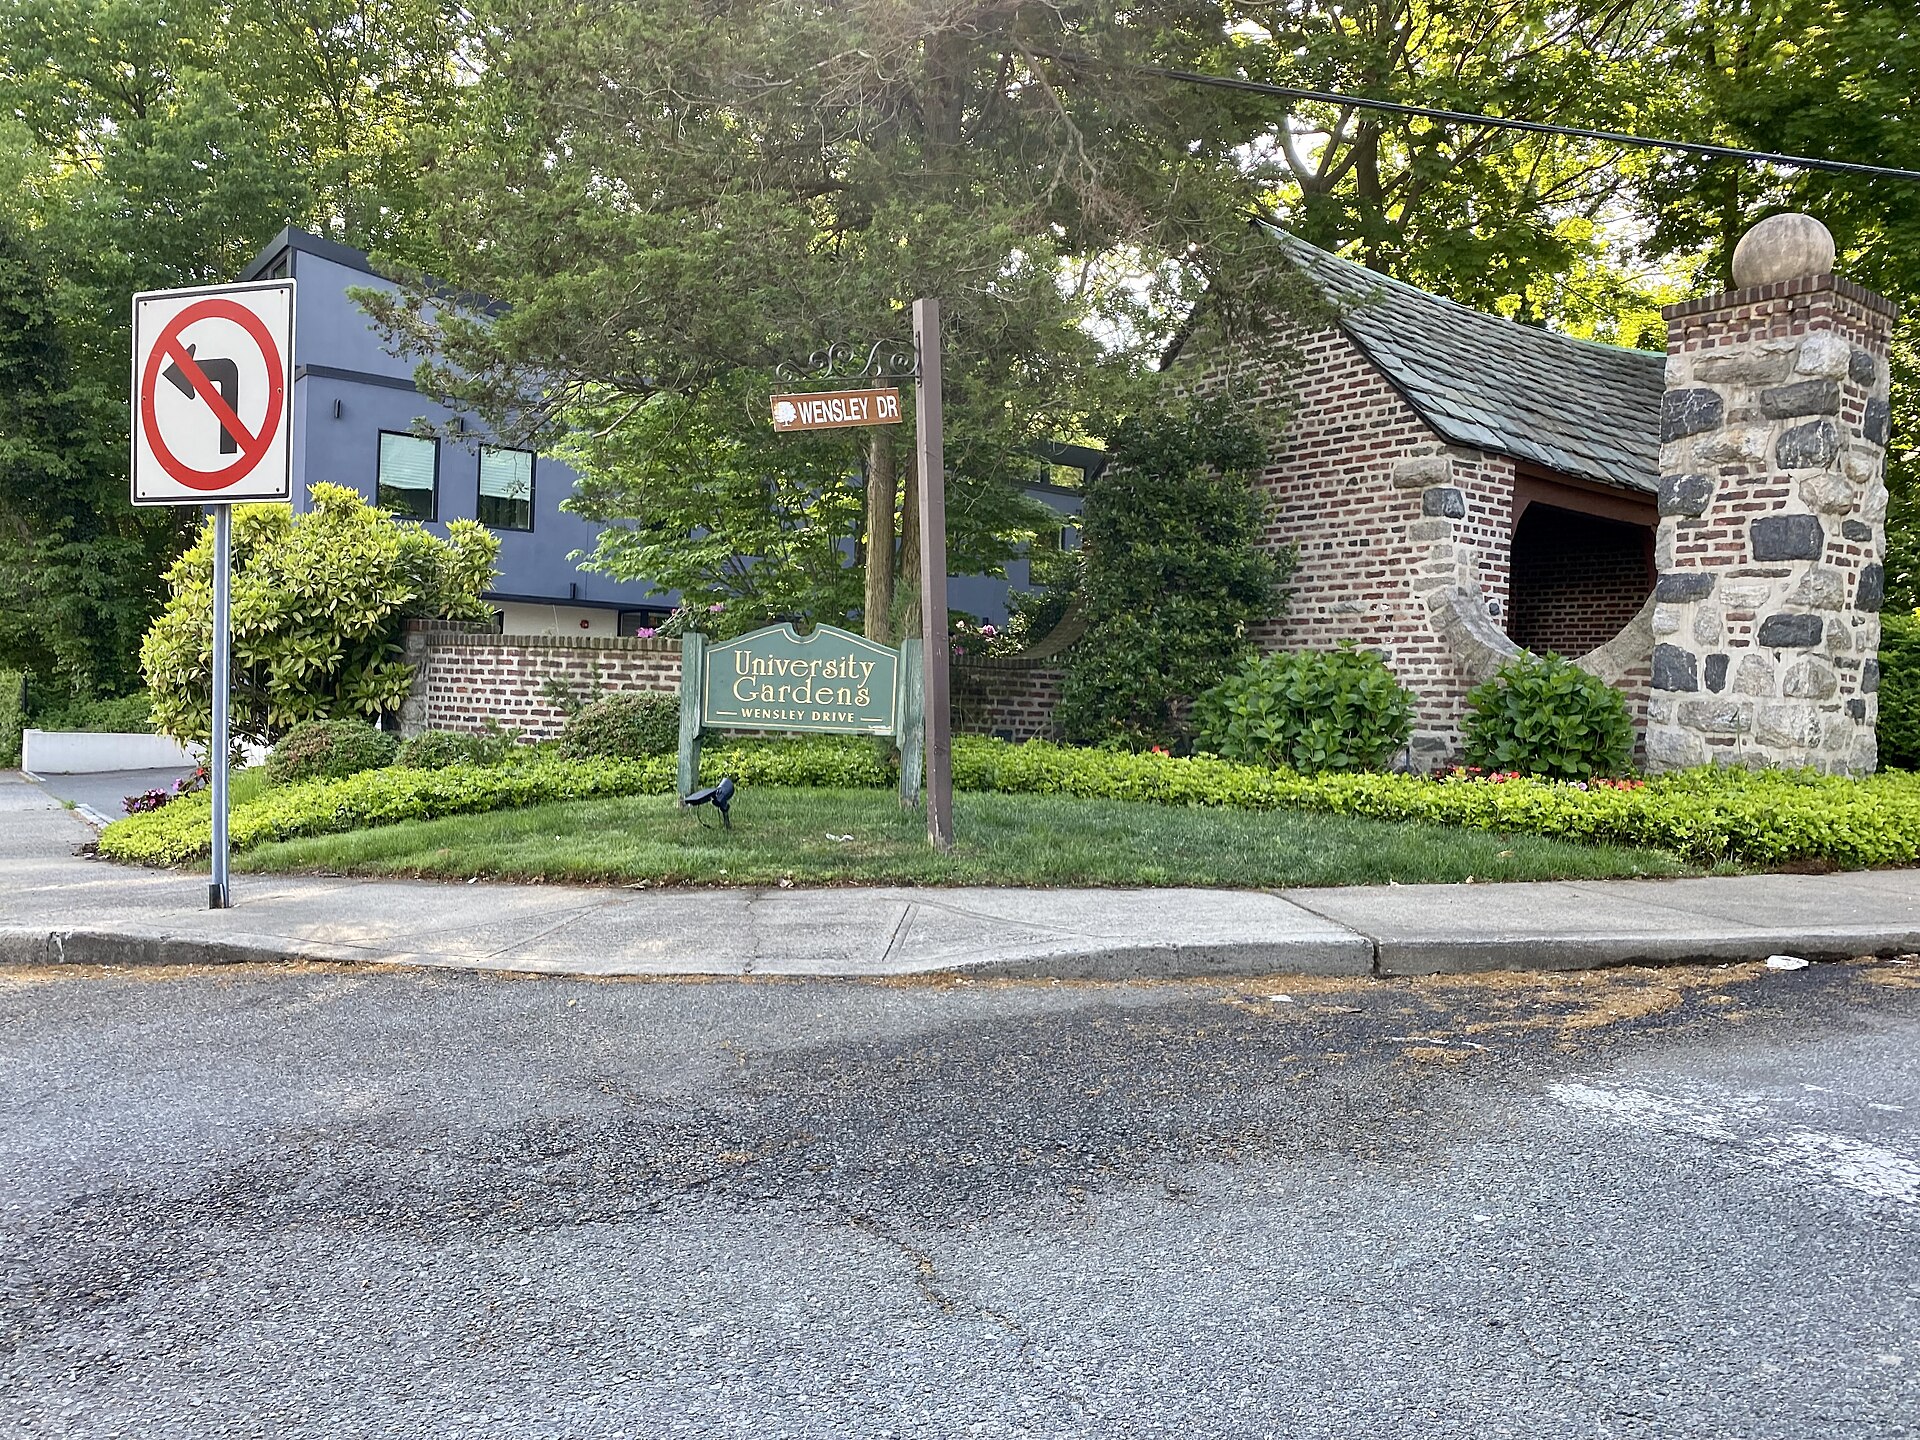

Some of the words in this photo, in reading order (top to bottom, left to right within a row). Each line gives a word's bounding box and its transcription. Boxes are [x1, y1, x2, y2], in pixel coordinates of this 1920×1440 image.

[797, 397, 868, 424] WENSLEY
[876, 395, 899, 418] DR
[734, 650, 876, 689] University
[733, 675, 871, 707] Gardens
[741, 708, 805, 721] WENSLEY
[811, 711, 855, 723] DRIVE
